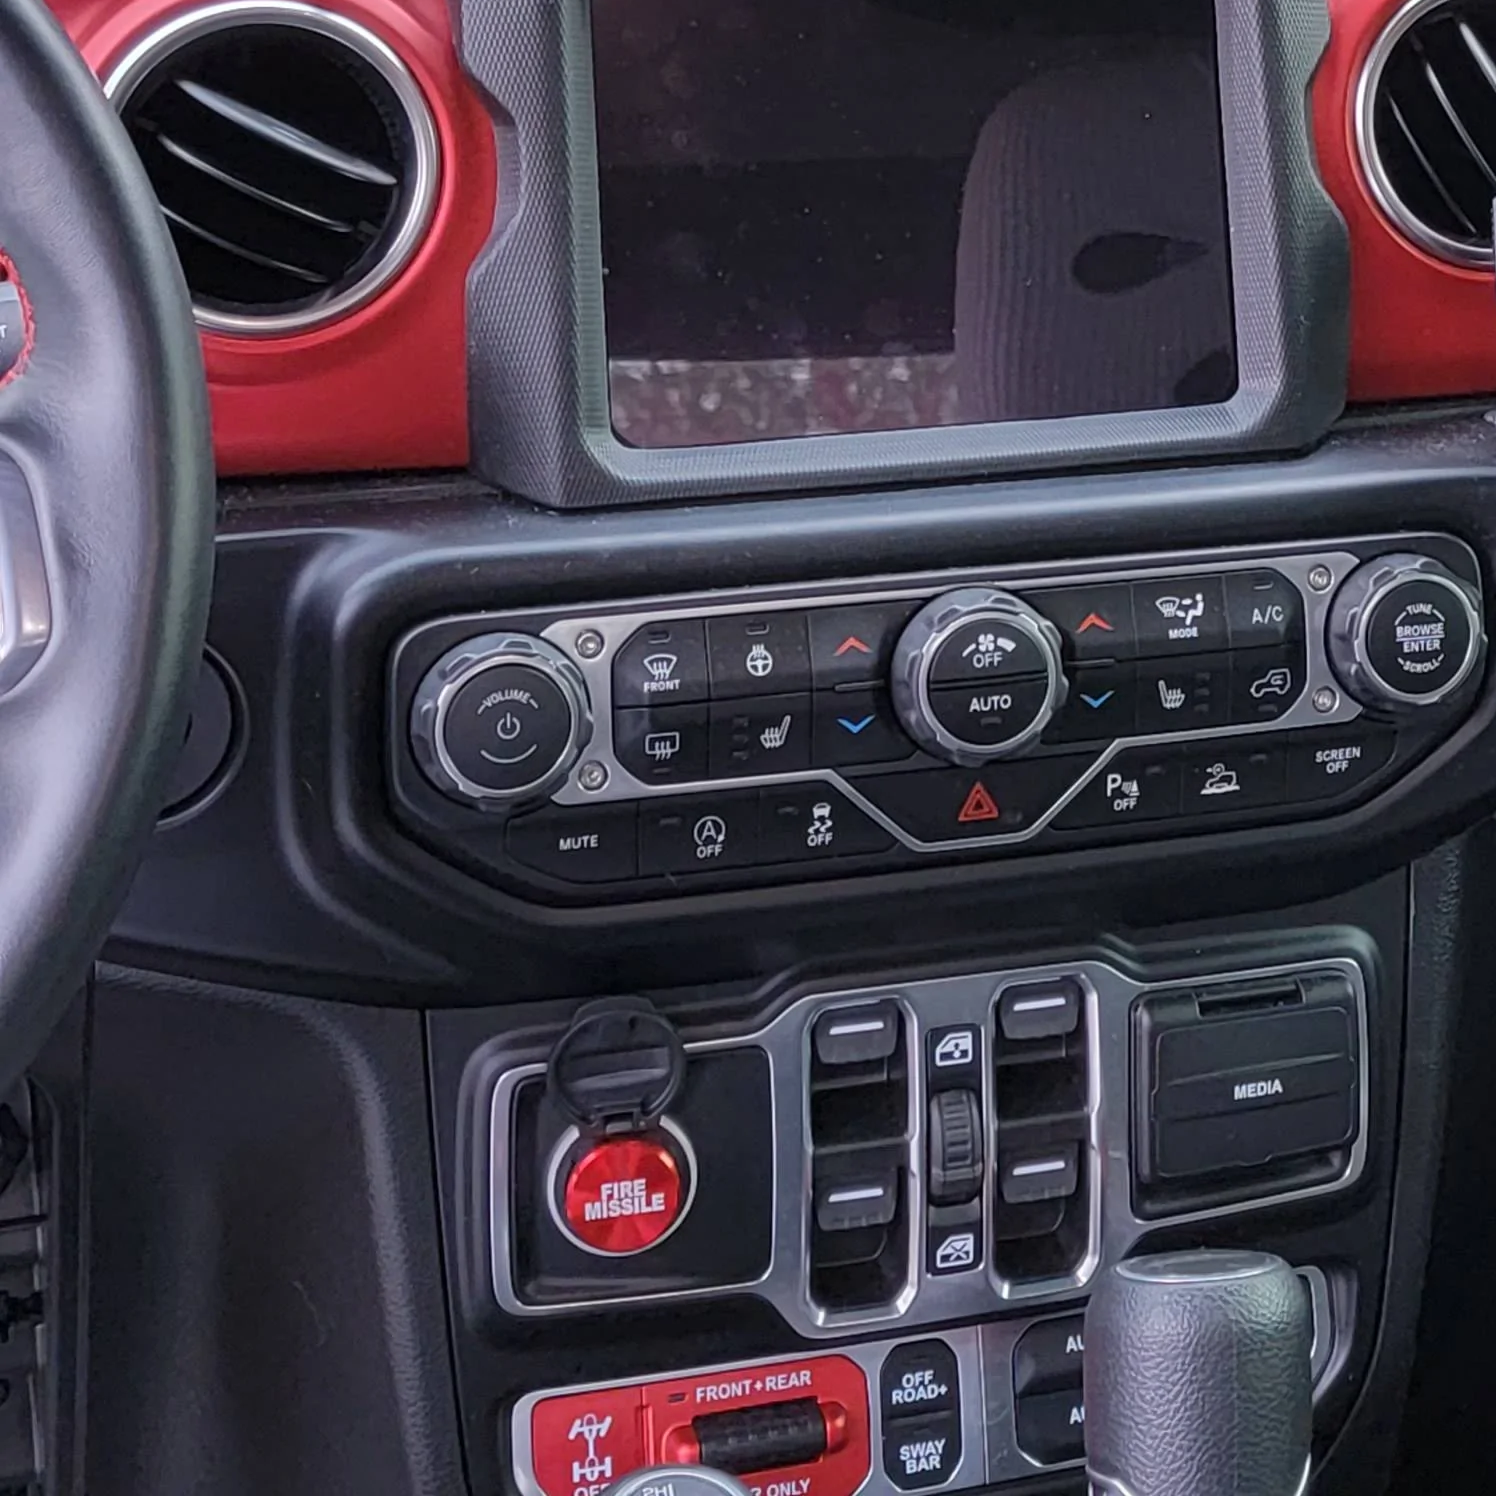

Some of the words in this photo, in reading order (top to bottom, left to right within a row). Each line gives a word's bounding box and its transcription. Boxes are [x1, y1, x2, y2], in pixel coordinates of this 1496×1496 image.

[1251, 605, 1284, 626] A/C
[1405, 602, 1433, 615] TUNE
[1168, 627, 1199, 640] MODE
[1395, 622, 1445, 638] BROWSE
[1402, 638, 1441, 653] ENTER
[972, 651, 1003, 670] OFF
[1402, 657, 1441, 674] SCROLL
[643, 678, 681, 693] FRONT
[482, 688, 531, 707] VOLUME
[968, 694, 1012, 713] AUTO
[1315, 746, 1361, 765] SCREEN
[1326, 759, 1350, 774] OFF
[1106, 774, 1122, 797] P
[1113, 797, 1137, 811] OFF
[558, 833, 599, 852] MUTE
[806, 831, 833, 847] OFF
[696, 843, 724, 859] OFF
[1233, 1078, 1283, 1101] MEDIA
[600, 1178, 647, 1201] FIRE
[584, 1192, 665, 1222] MISSILE
[901, 1370, 934, 1389] OFF
[891, 1382, 949, 1405] ROAD+
[899, 1439, 946, 1463] SWAY
[905, 1454, 942, 1475] BAR
[766, 1476, 811, 1496] ONLY
